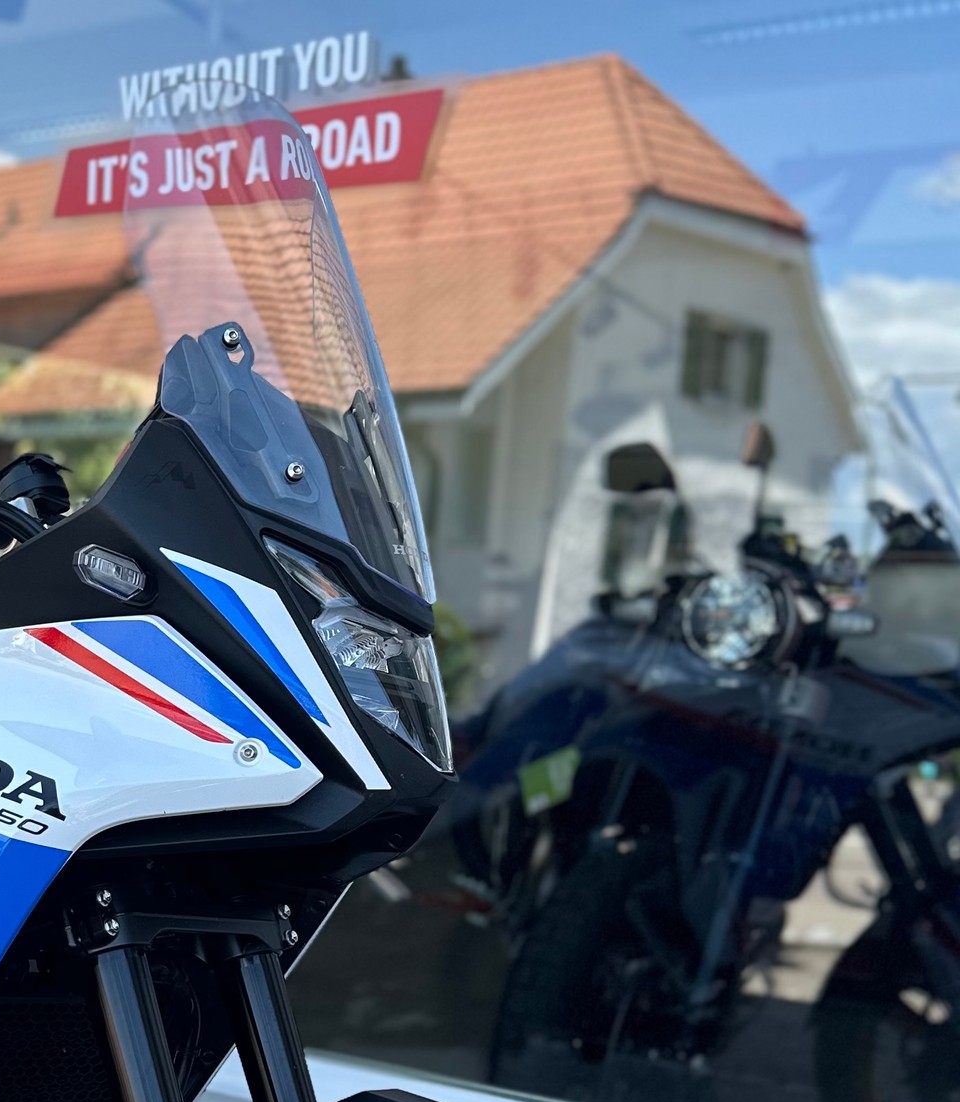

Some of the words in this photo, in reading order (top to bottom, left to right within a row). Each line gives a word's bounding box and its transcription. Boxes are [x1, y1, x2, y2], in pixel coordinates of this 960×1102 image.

[119, 47, 284, 119] WITHOUT
[294, 31, 370, 91] YOU
[86, 151, 149, 205] IT'S
[158, 140, 238, 195] JUST
[244, 136, 271, 186] A
